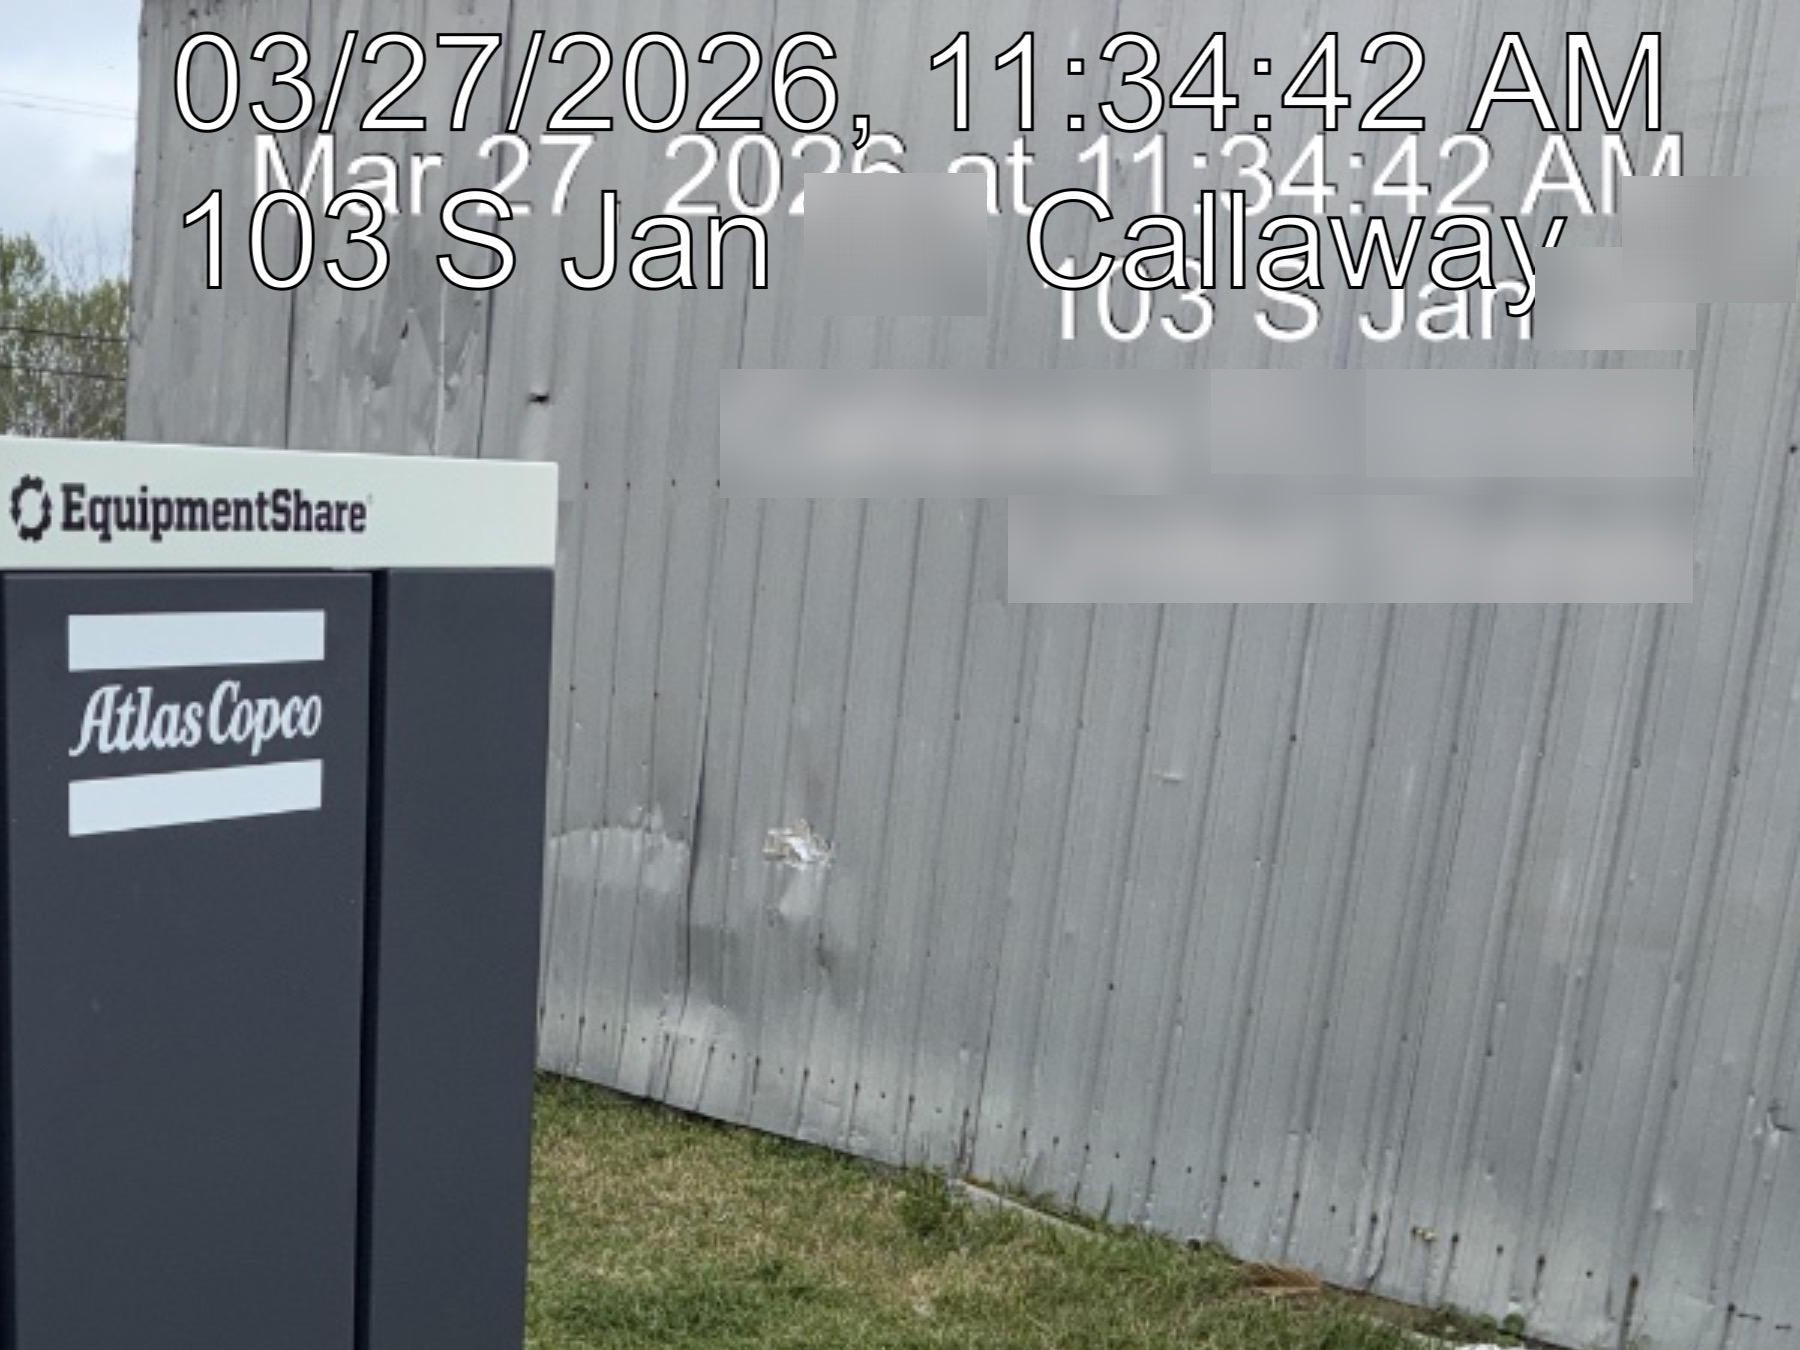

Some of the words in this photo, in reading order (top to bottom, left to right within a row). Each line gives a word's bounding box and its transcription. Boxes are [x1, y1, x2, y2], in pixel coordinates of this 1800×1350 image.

[60, 481, 367, 543] EquipmentShare
[69, 681, 205, 757] Atlas
[208, 679, 322, 757] Copco
